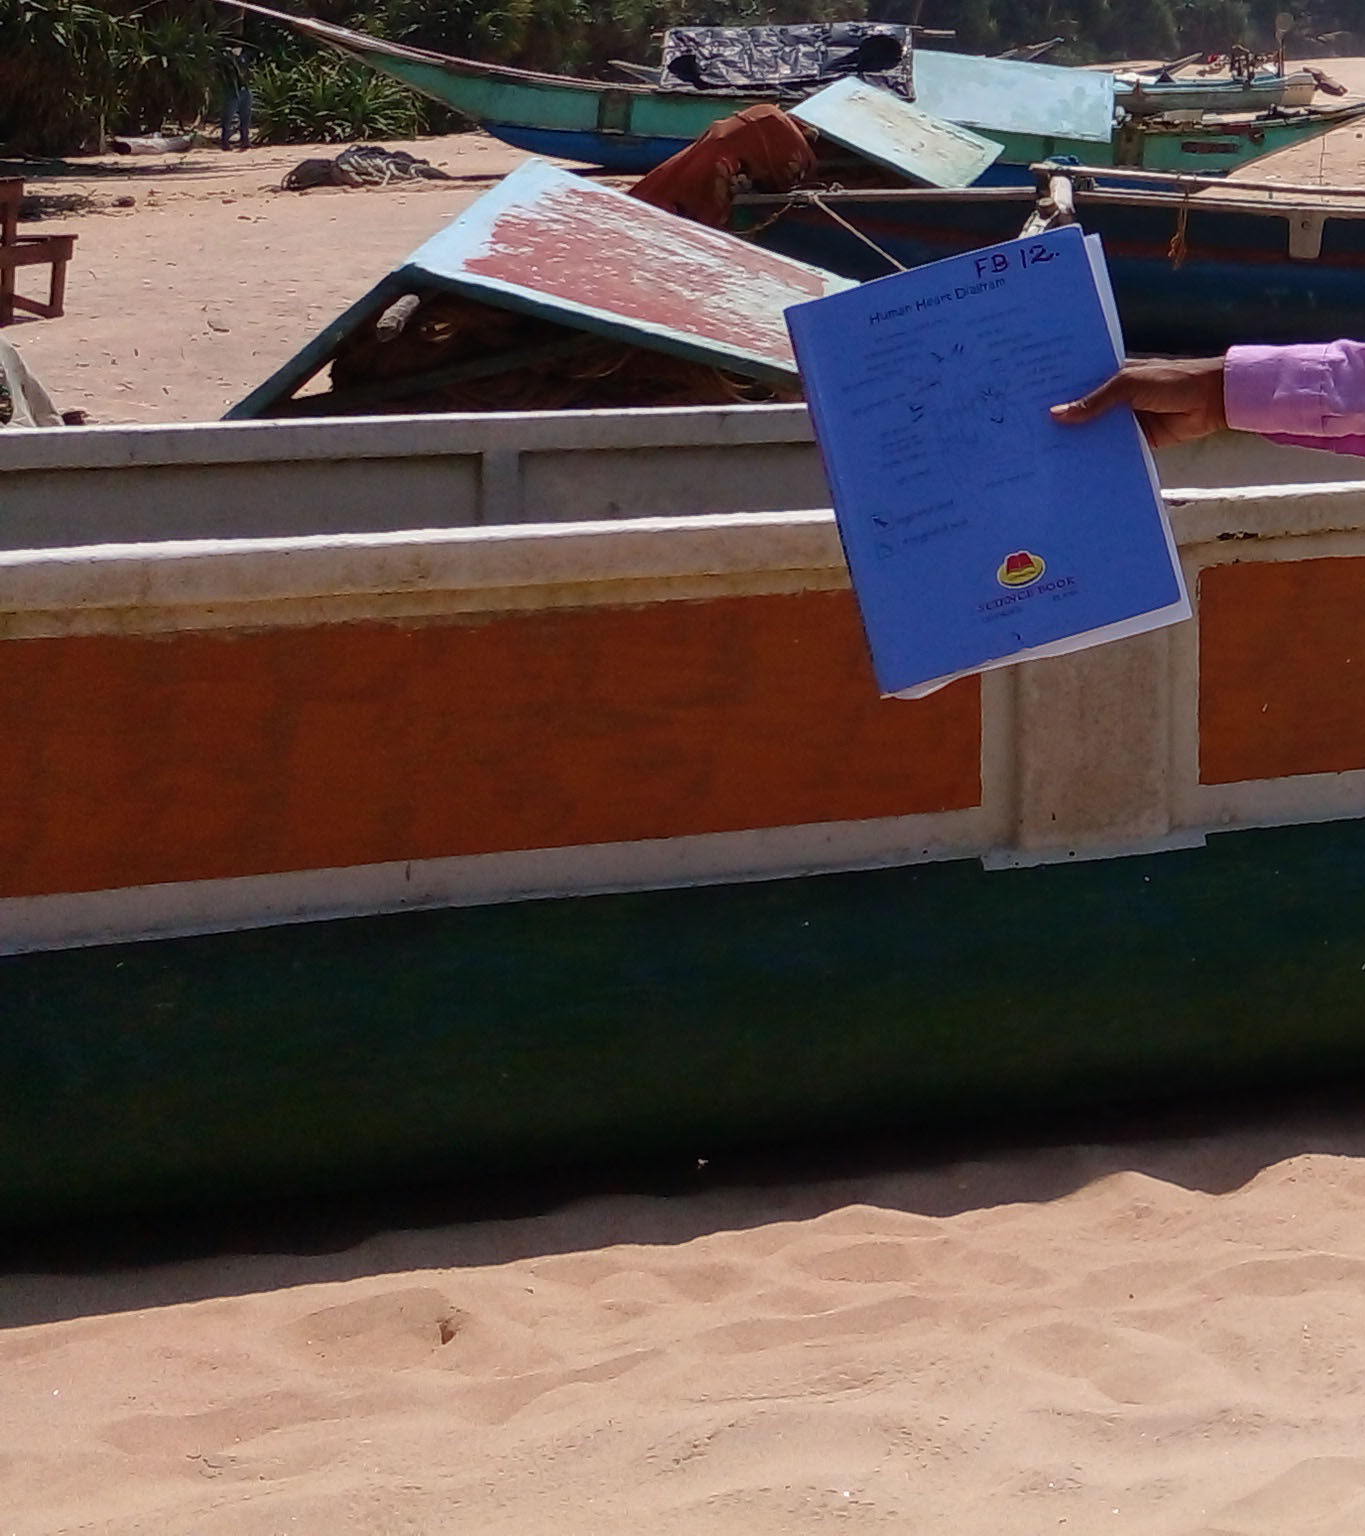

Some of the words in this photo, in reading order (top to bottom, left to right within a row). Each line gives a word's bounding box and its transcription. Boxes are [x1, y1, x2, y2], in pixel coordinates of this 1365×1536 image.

[974, 253, 1009, 279] FB
[869, 304, 912, 325] Human
[916, 293, 952, 311] Heart
